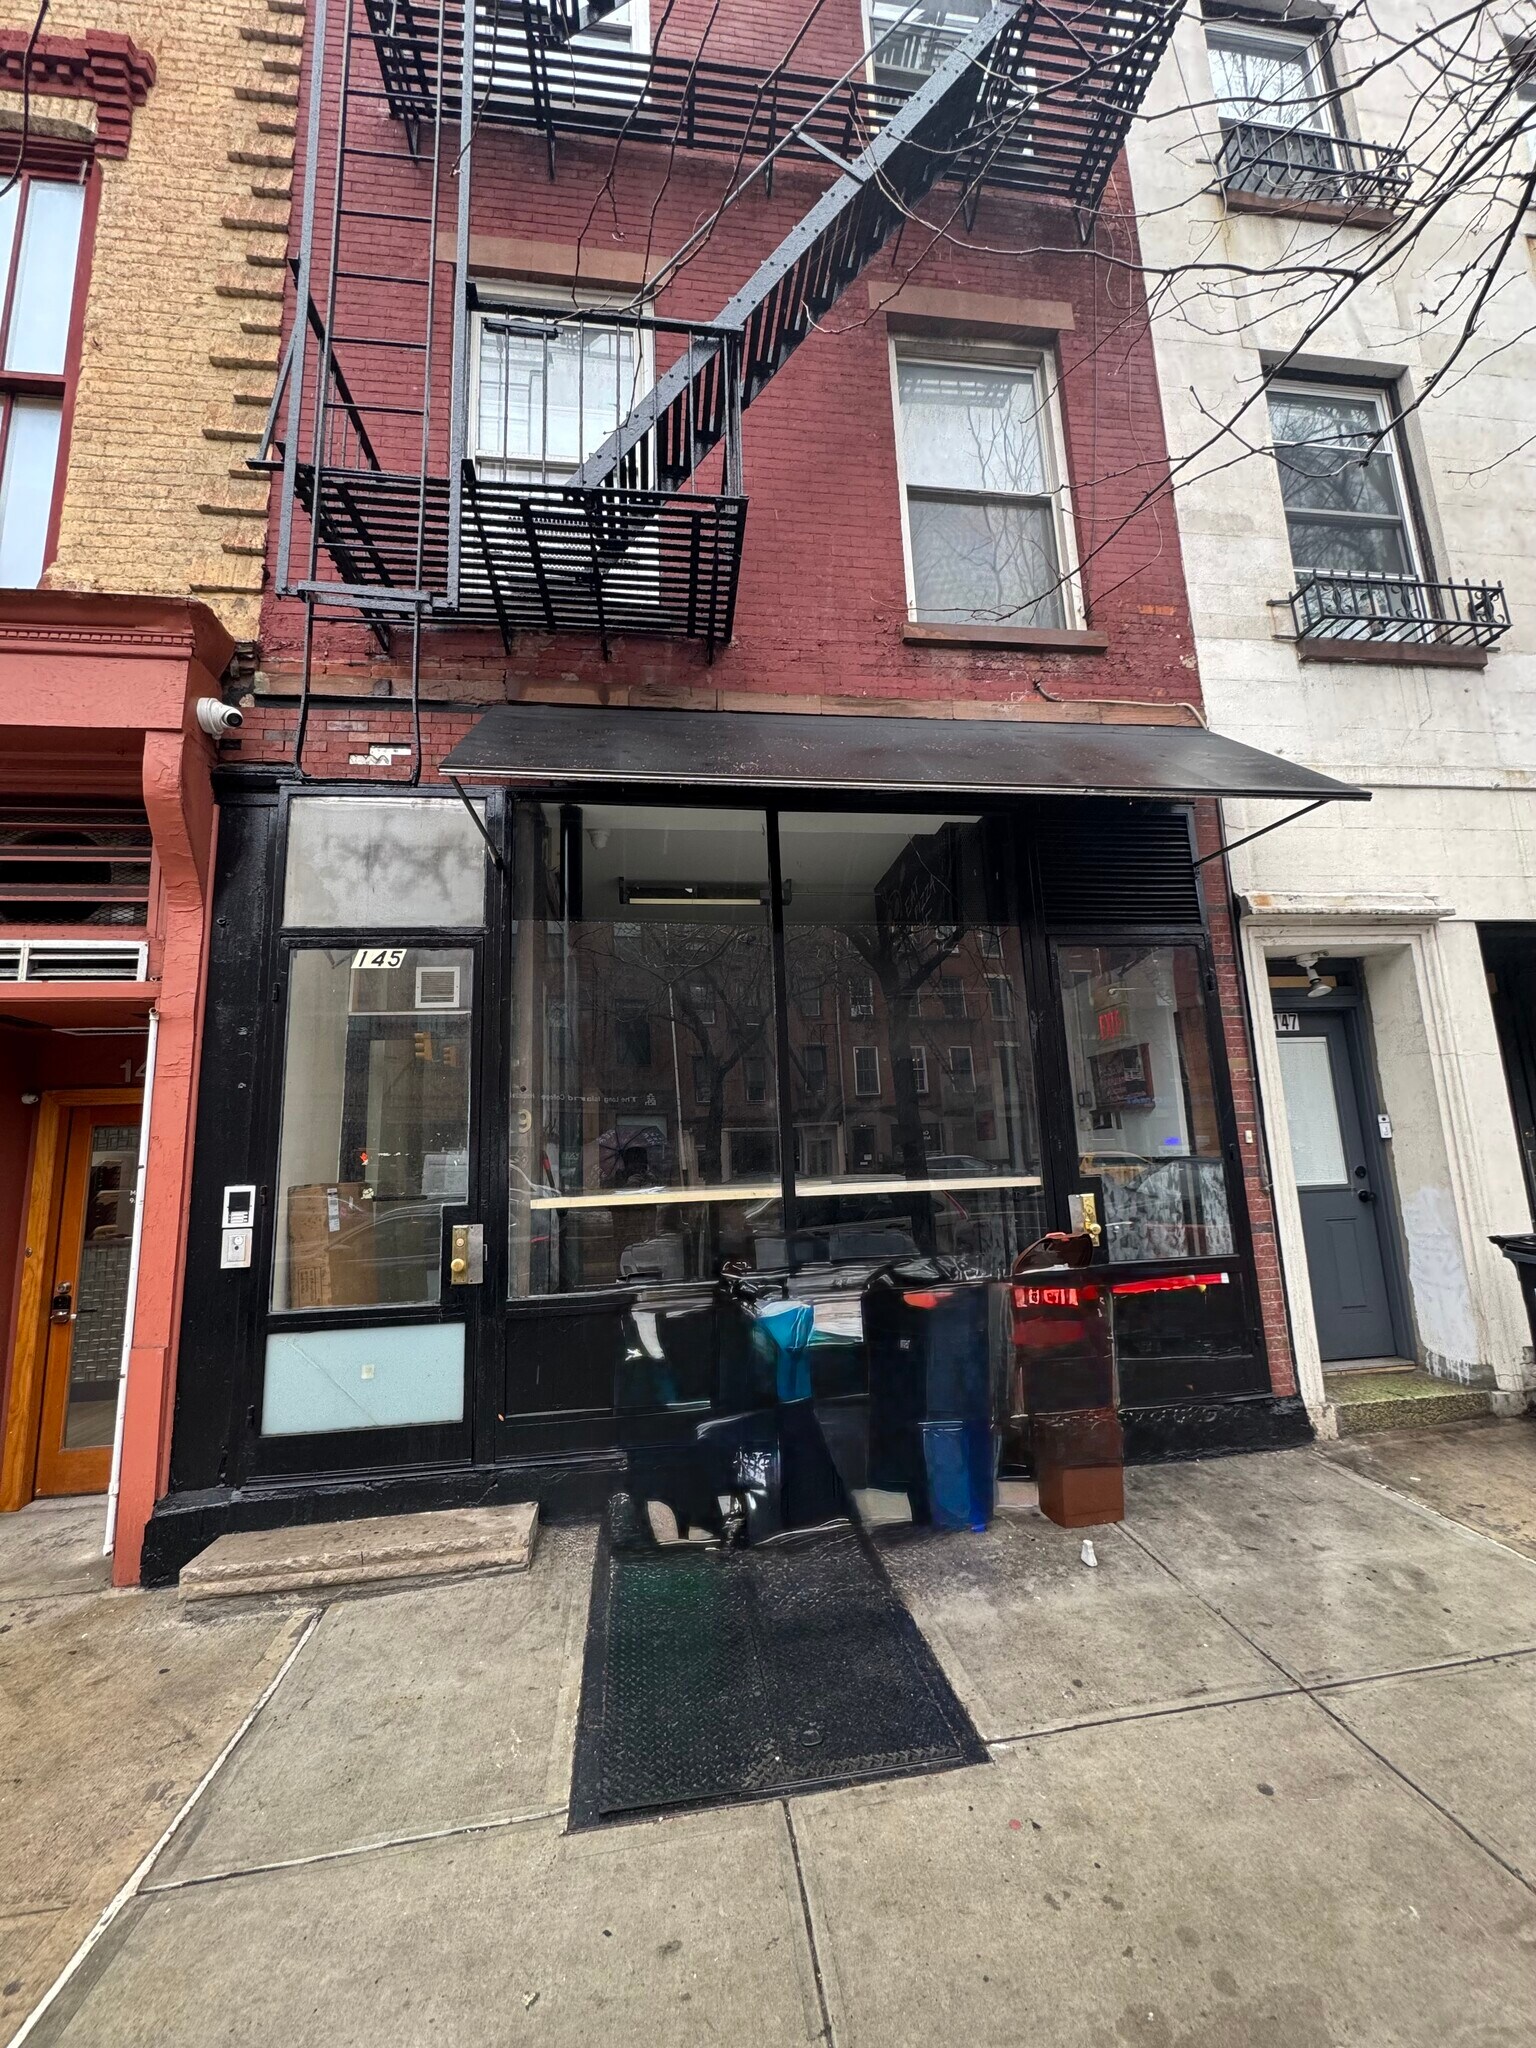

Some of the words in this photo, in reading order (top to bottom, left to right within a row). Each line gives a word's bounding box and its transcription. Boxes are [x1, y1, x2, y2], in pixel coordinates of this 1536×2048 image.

[358, 950, 404, 968] 145
[1273, 1014, 1297, 1031] 147
[119, 1059, 147, 1083] 14
